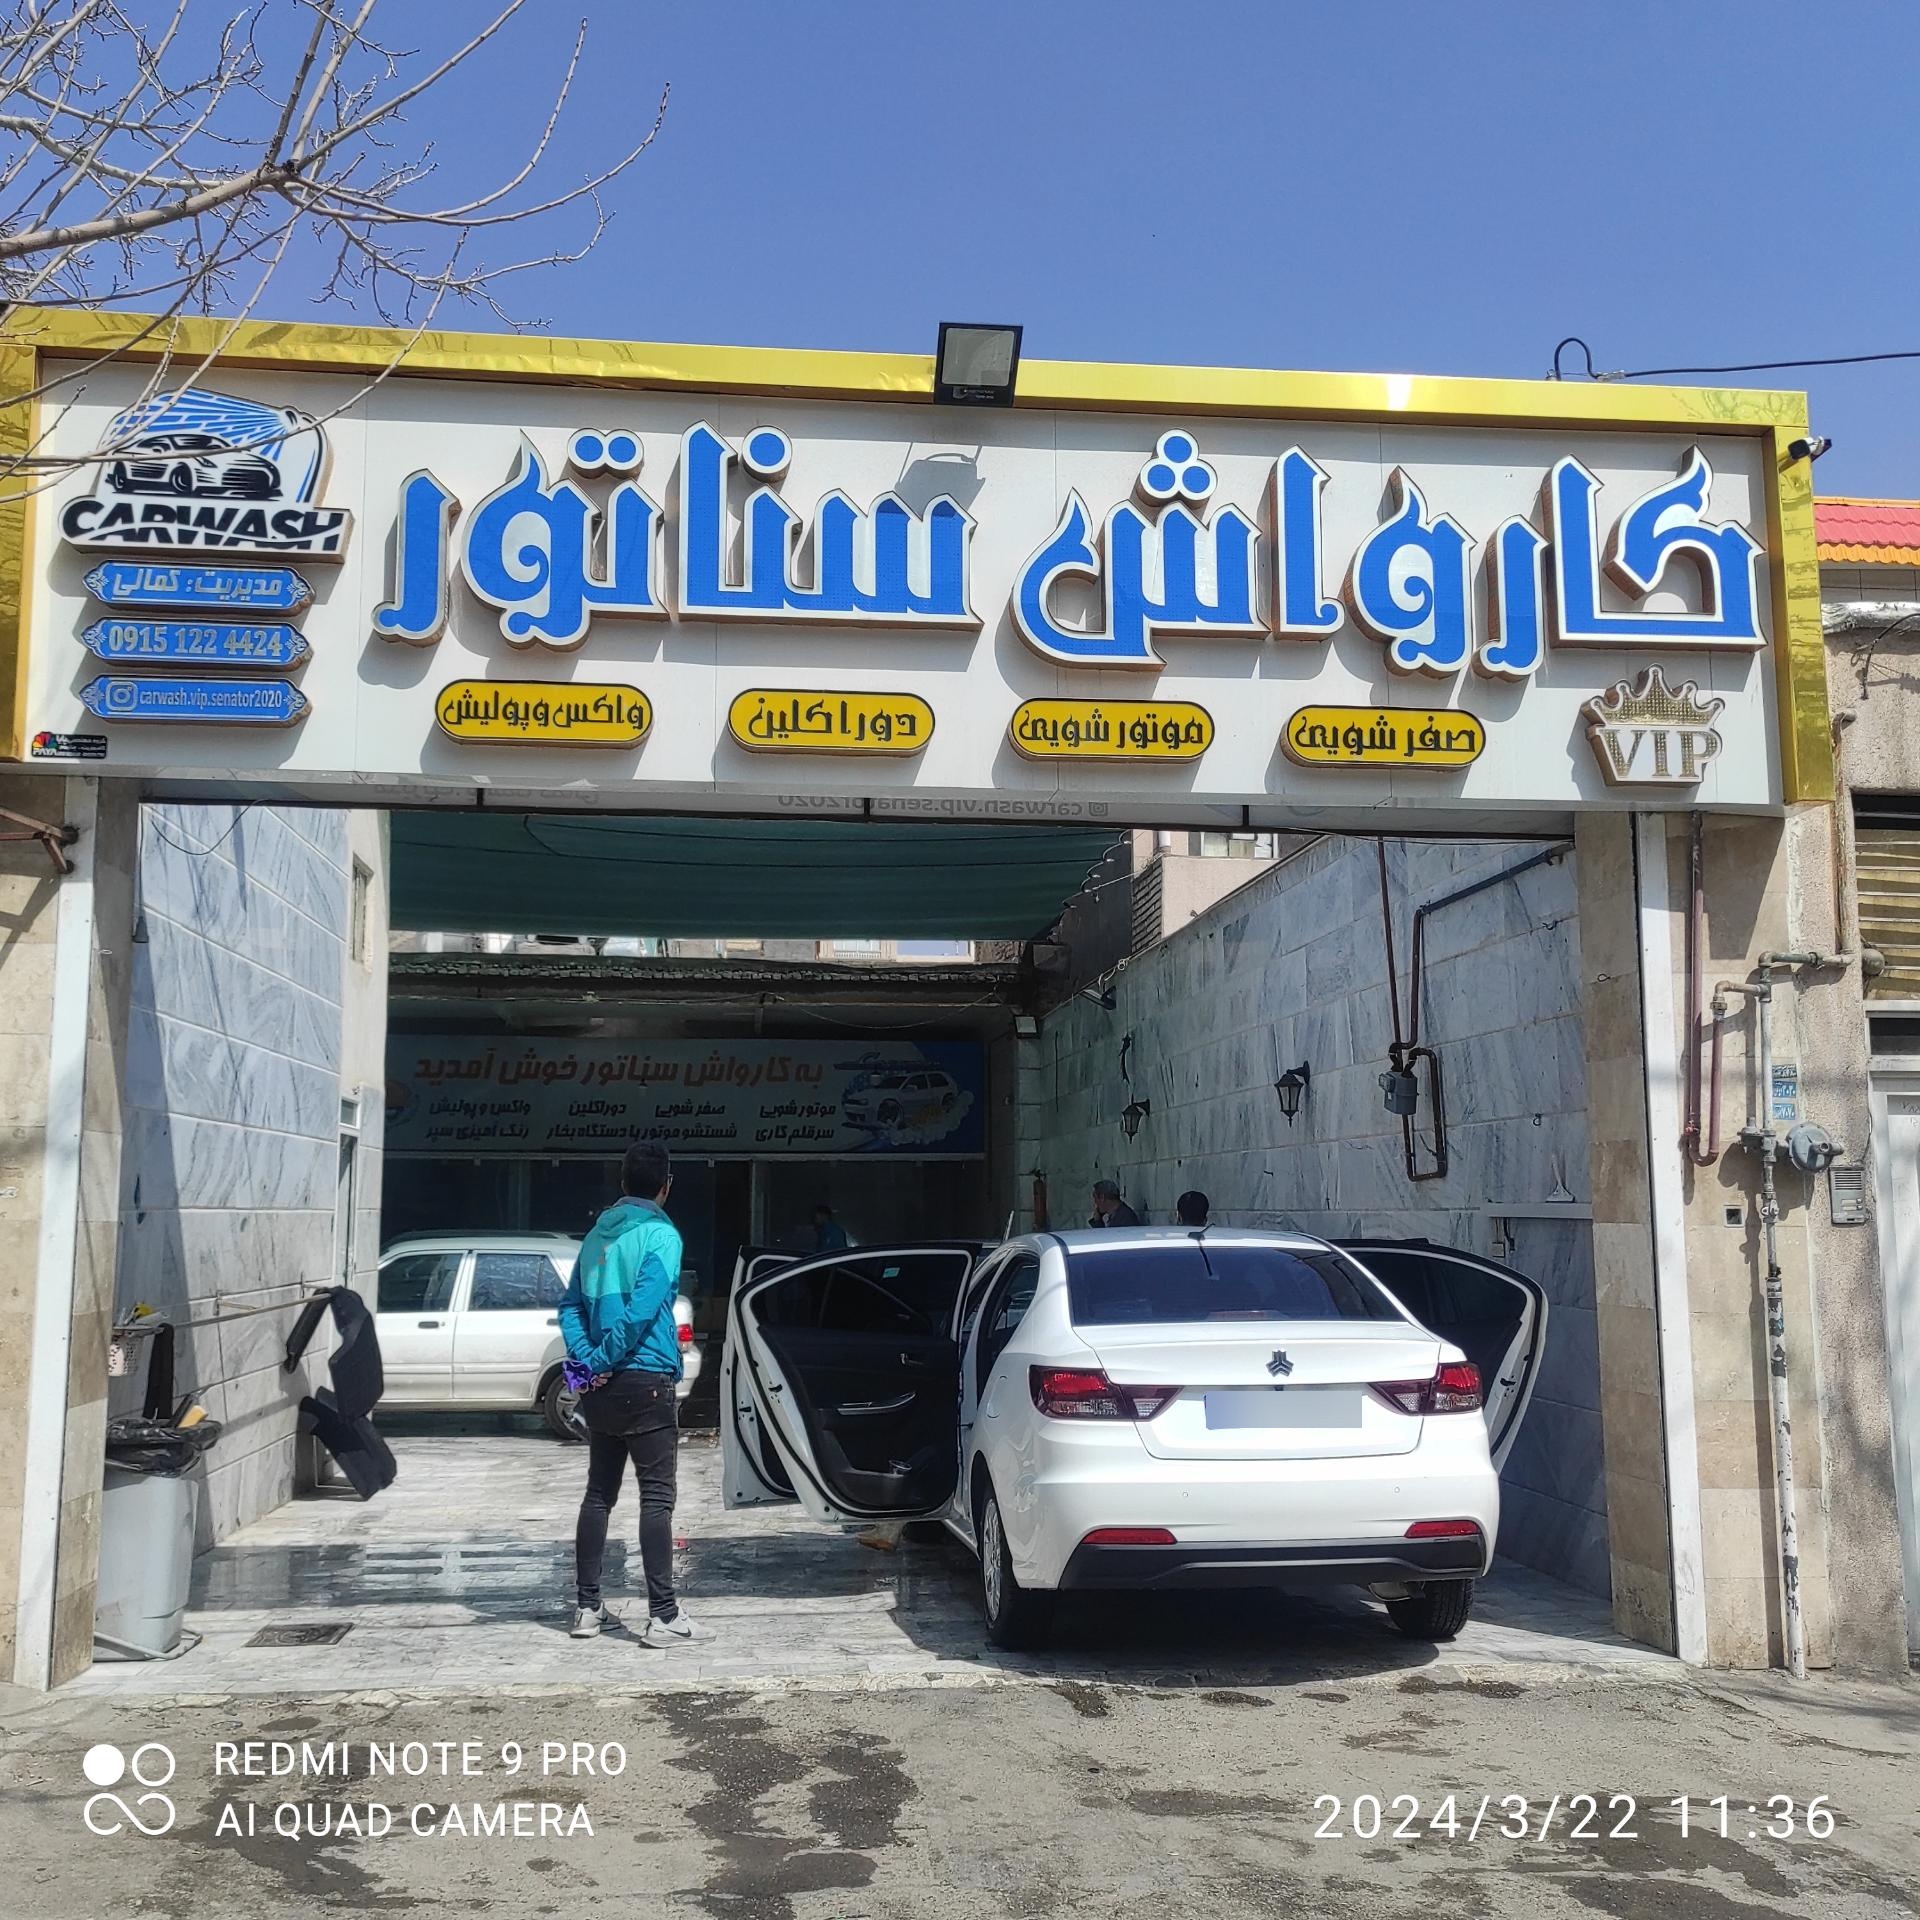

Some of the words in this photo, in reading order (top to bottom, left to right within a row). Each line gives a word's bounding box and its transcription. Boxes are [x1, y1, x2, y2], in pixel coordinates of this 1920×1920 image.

[63, 499, 344, 551] CARWASH
[370, 419, 984, 648] سناتور
[1011, 429, 1767, 677] کارواش
[112, 568, 181, 597] کمالی
[108, 625, 168, 653] 0915
[174, 627, 217, 655] 122
[223, 629, 282, 657] 4424
[139, 687, 283, 710] carwash.vip.senator2020
[552, 692, 644, 730] واکس
[1115, 712, 1204, 750] موتور
[1403, 715, 1476, 757] صفر
[1598, 729, 1719, 779] VIP
[415, 1047, 498, 1087] آمدید
[498, 1047, 578, 1086] خوش
[579, 1055, 679, 1086] سناتور
[683, 1049, 791, 1088] کارواش
